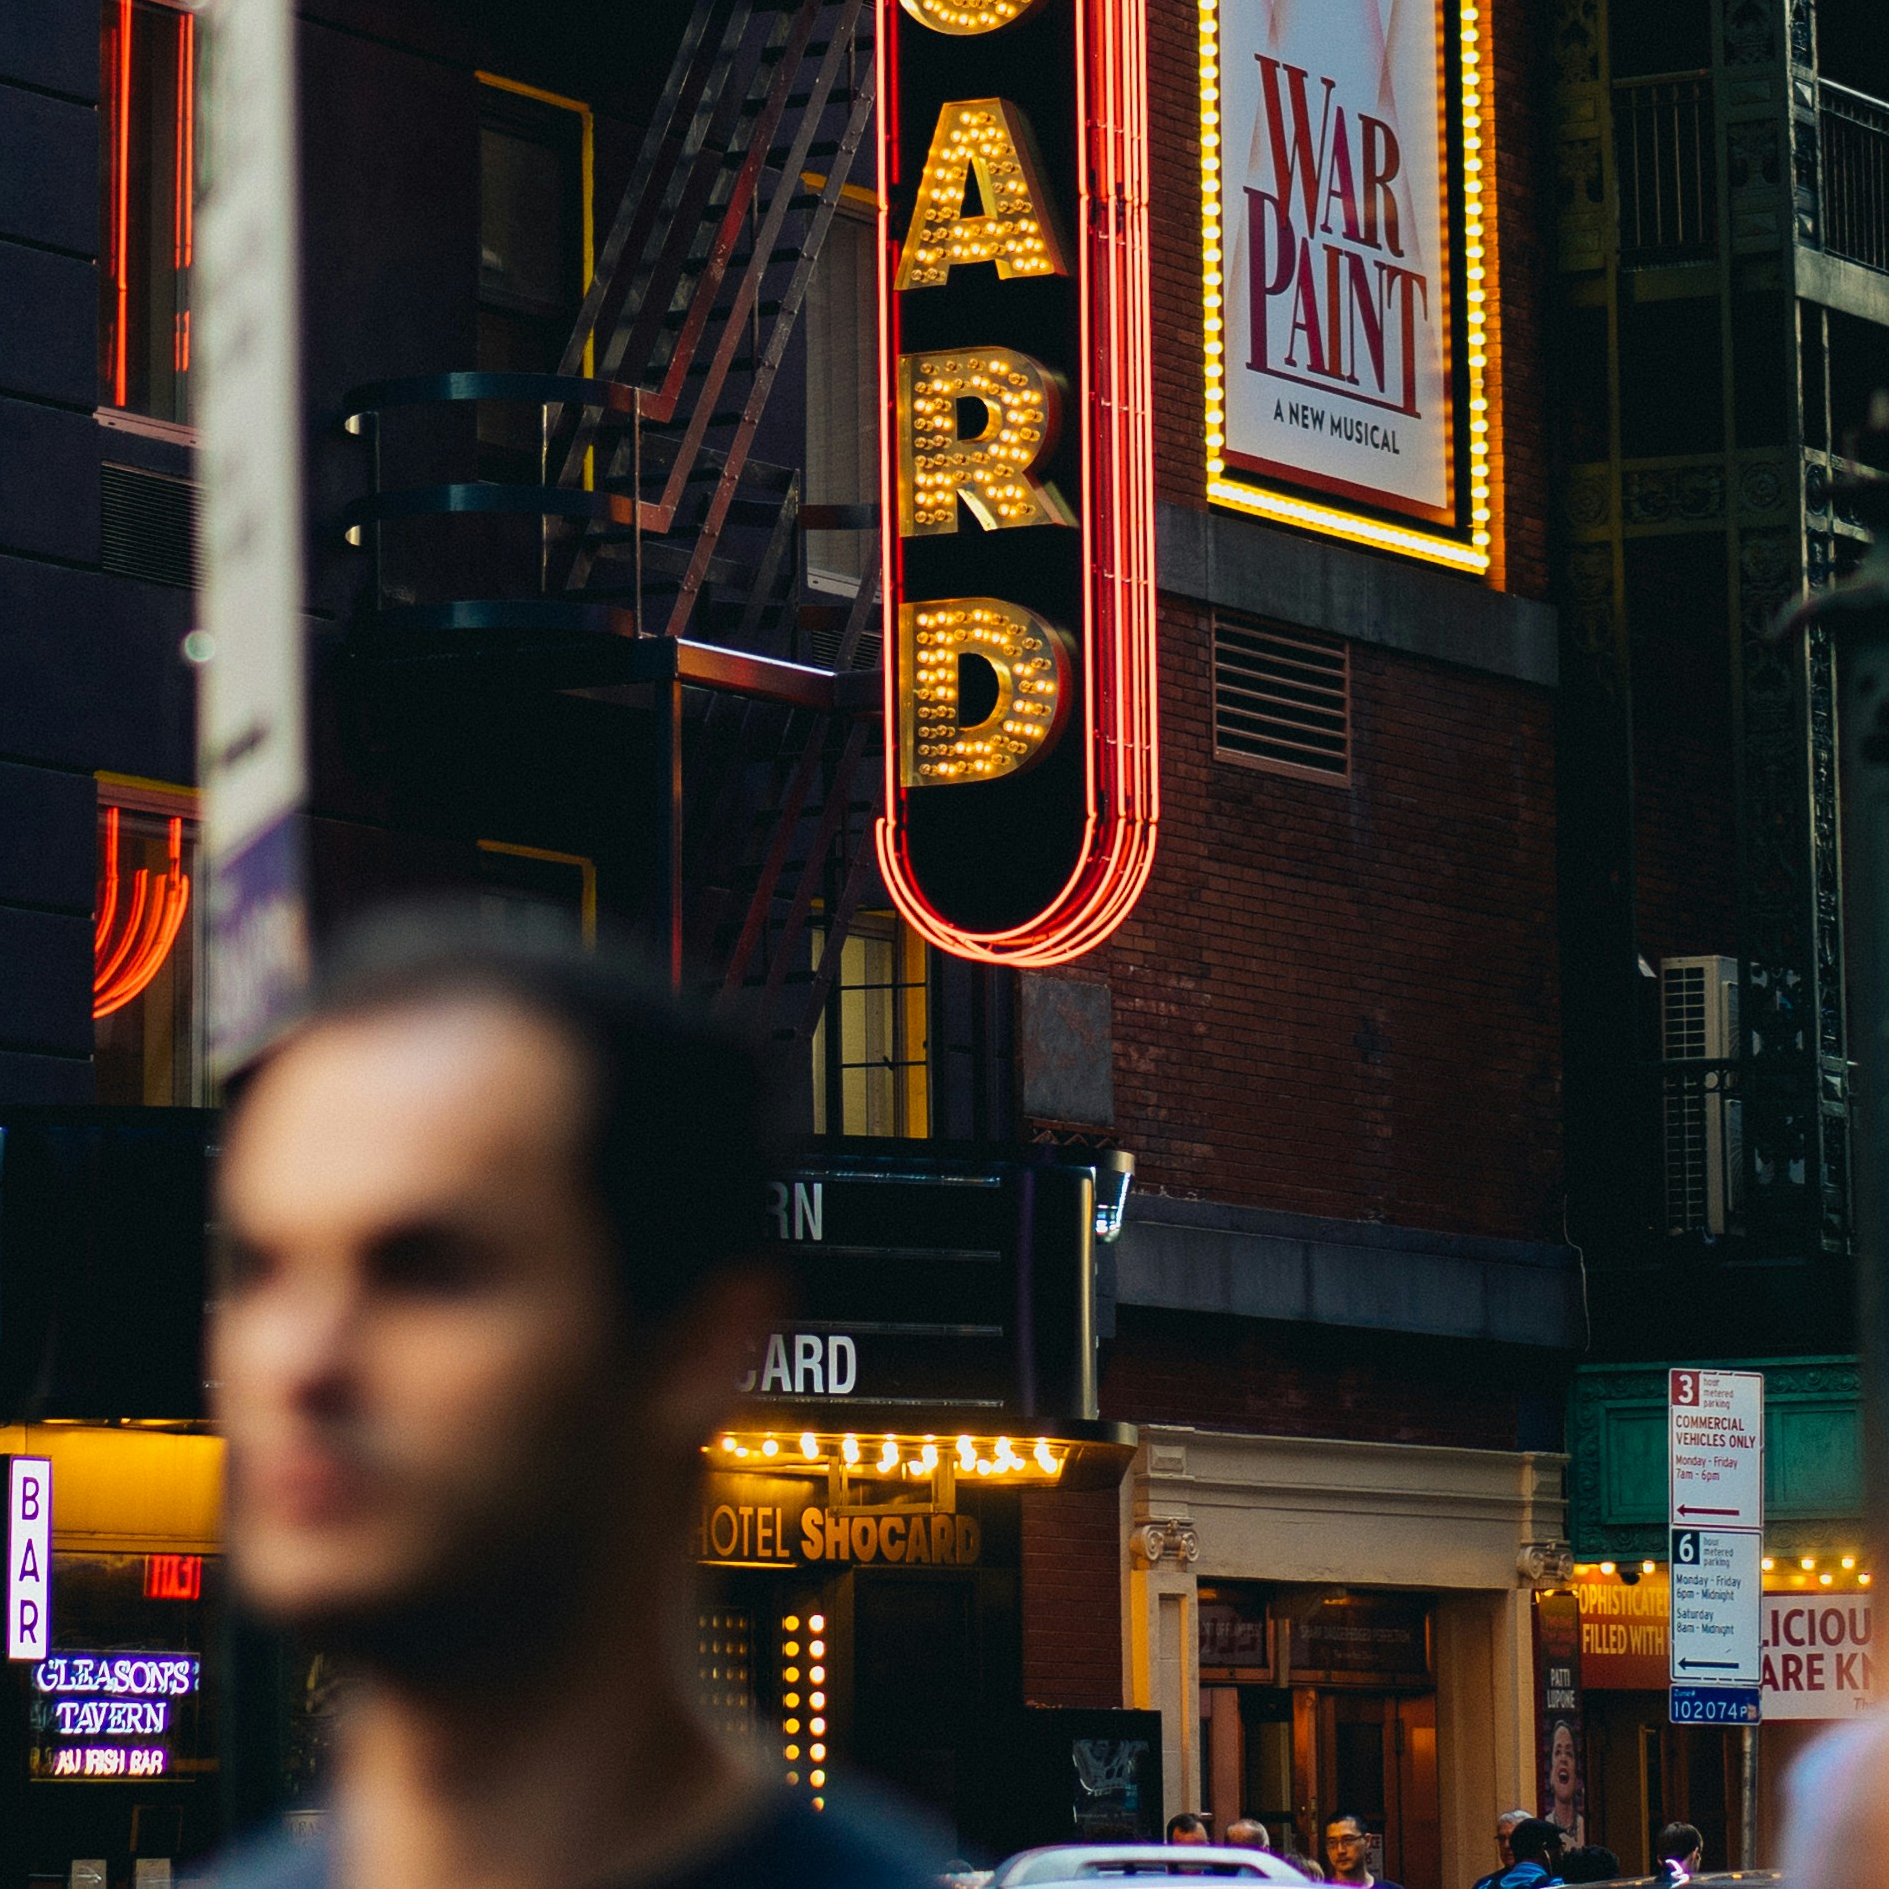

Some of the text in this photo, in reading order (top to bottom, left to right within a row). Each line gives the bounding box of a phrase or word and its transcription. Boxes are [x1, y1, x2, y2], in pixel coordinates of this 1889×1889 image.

[1254, 53, 1405, 258] WAR
[1243, 185, 1428, 420] PAINT
[1273, 398, 1400, 455] A NEW MUSICAL
[1678, 1374, 1694, 1404] 3
[1703, 1377, 1720, 1387] hour
[1703, 1388, 1734, 1399] metered
[1703, 1399, 1731, 1410] parking
[1675, 1415, 1745, 1432] COMMERCIAL
[1675, 1432, 1756, 1449] VEHICLES ONLY
[1675, 1454, 1707, 1467] Monday
[1713, 1456, 1739, 1469] Friday
[1675, 1468, 1694, 1480] 7am
[1701, 1469, 1720, 1482] 6pm
[800, 1506, 981, 1564] SHOCARD
[1703, 1536, 1720, 1546] hour
[1678, 1532, 1695, 1563] 6
[1703, 1547, 1734, 1558] metered
[18, 1475, 41, 1645] BAR
[1703, 1558, 1731, 1569] parking
[1675, 1573, 1709, 1588] Monday
[1716, 1575, 1742, 1590] Friday
[1675, 1588, 1695, 1601] 6pm
[1701, 1589, 1735, 1603] Midnight
[1676, 1608, 1715, 1622] Saturday
[1676, 1622, 1695, 1633] 8am
[1701, 1623, 1735, 1637] Midnight
[1582, 1623, 1627, 1655] FILLED
[1629, 1625, 1665, 1656] WITH
[1550, 1668, 1571, 1688] PATTI
[1547, 1689, 1576, 1709] LUPONE
[55, 1702, 167, 1734] TAVERN
[84, 1748, 125, 1776] IRISH
[127, 1749, 164, 1776] BAR
